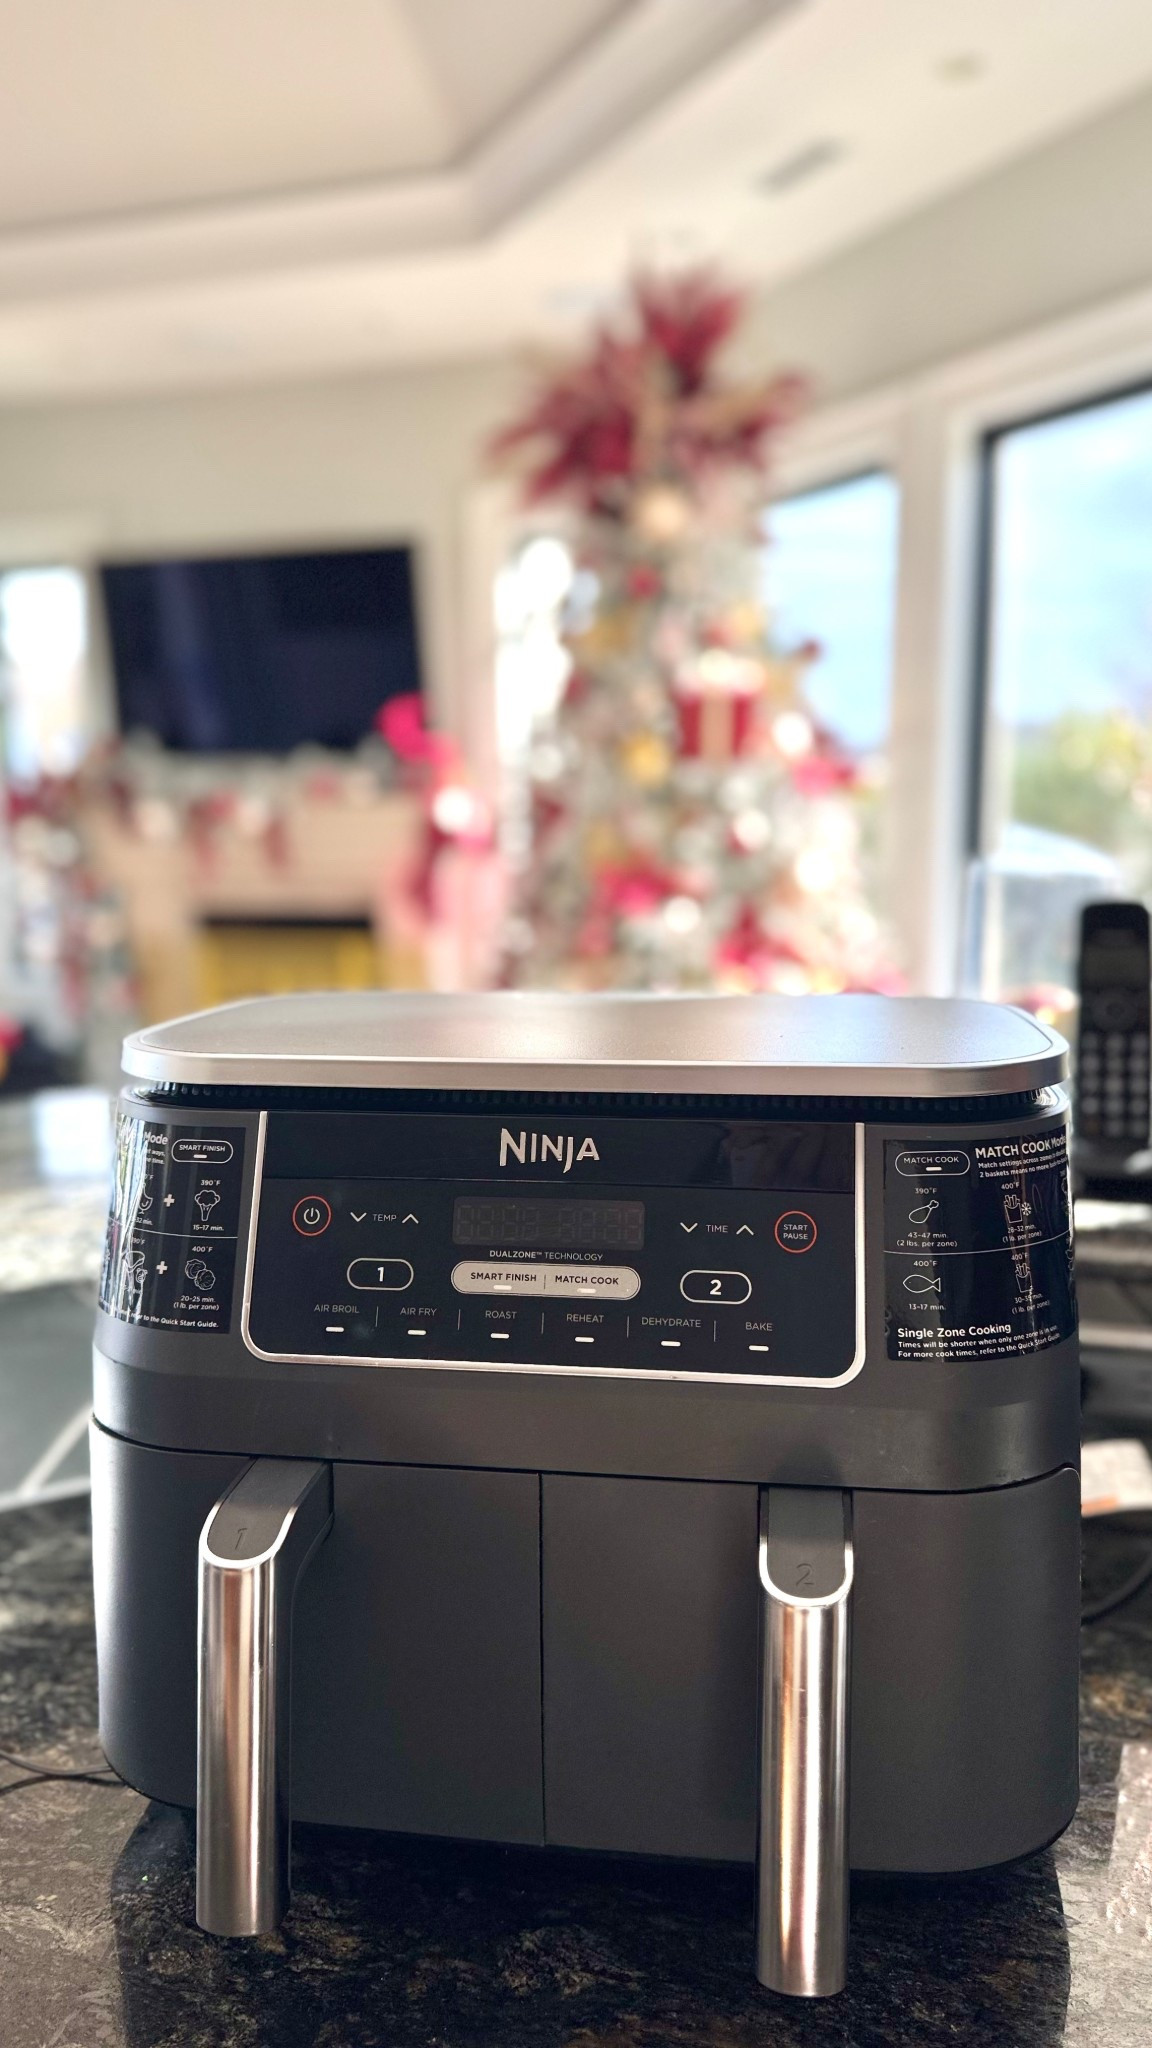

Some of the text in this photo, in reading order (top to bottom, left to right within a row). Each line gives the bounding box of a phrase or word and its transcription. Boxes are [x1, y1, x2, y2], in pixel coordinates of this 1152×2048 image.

[143, 1132, 169, 1145] Mode
[499, 1128, 600, 1173] NINJA
[975, 1144, 1019, 1159] MATCH
[1021, 1140, 1051, 1154] COOK
[999, 1159, 1022, 1168] settings
[1022, 1157, 1039, 1165] across
[985, 1169, 1010, 1177] baskets
[1010, 1167, 1028, 1175] means
[1036, 1163, 1049, 1171] more
[1001, 1182, 1020, 1190] 400°F
[372, 1214, 397, 1222] TEMP
[706, 1224, 728, 1233] TIME
[544, 1252, 603, 1261] TECHNOLOGY
[376, 1266, 385, 1282] 1
[470, 1272, 537, 1282] SMART FINISH
[554, 1275, 619, 1286] MATCH COOK
[709, 1279, 722, 1296] 2
[314, 1304, 360, 1314] AIR BROIL
[400, 1307, 437, 1317] AIR FRY
[485, 1310, 517, 1320] ROAST
[566, 1313, 605, 1323] REHEAT
[161, 1318, 179, 1326] Quick
[641, 1317, 702, 1328] DEHYDRATE
[745, 1321, 773, 1332] BAKE
[897, 1323, 1012, 1340] Single Zone Cooking
[898, 1341, 921, 1349] Times
[938, 1340, 949, 1348] be
[950, 1340, 977, 1348] shorter
[978, 1338, 997, 1346] when
[998, 1336, 1012, 1344] only
[1025, 1331, 1039, 1339] zone
[935, 1350, 955, 1358] cook
[955, 1349, 979, 1357] times,
[1006, 1344, 1017, 1352] the
[1017, 1341, 1034, 1350] Quick
[1034, 1337, 1047, 1346] Start
[796, 1562, 815, 1586] 2
